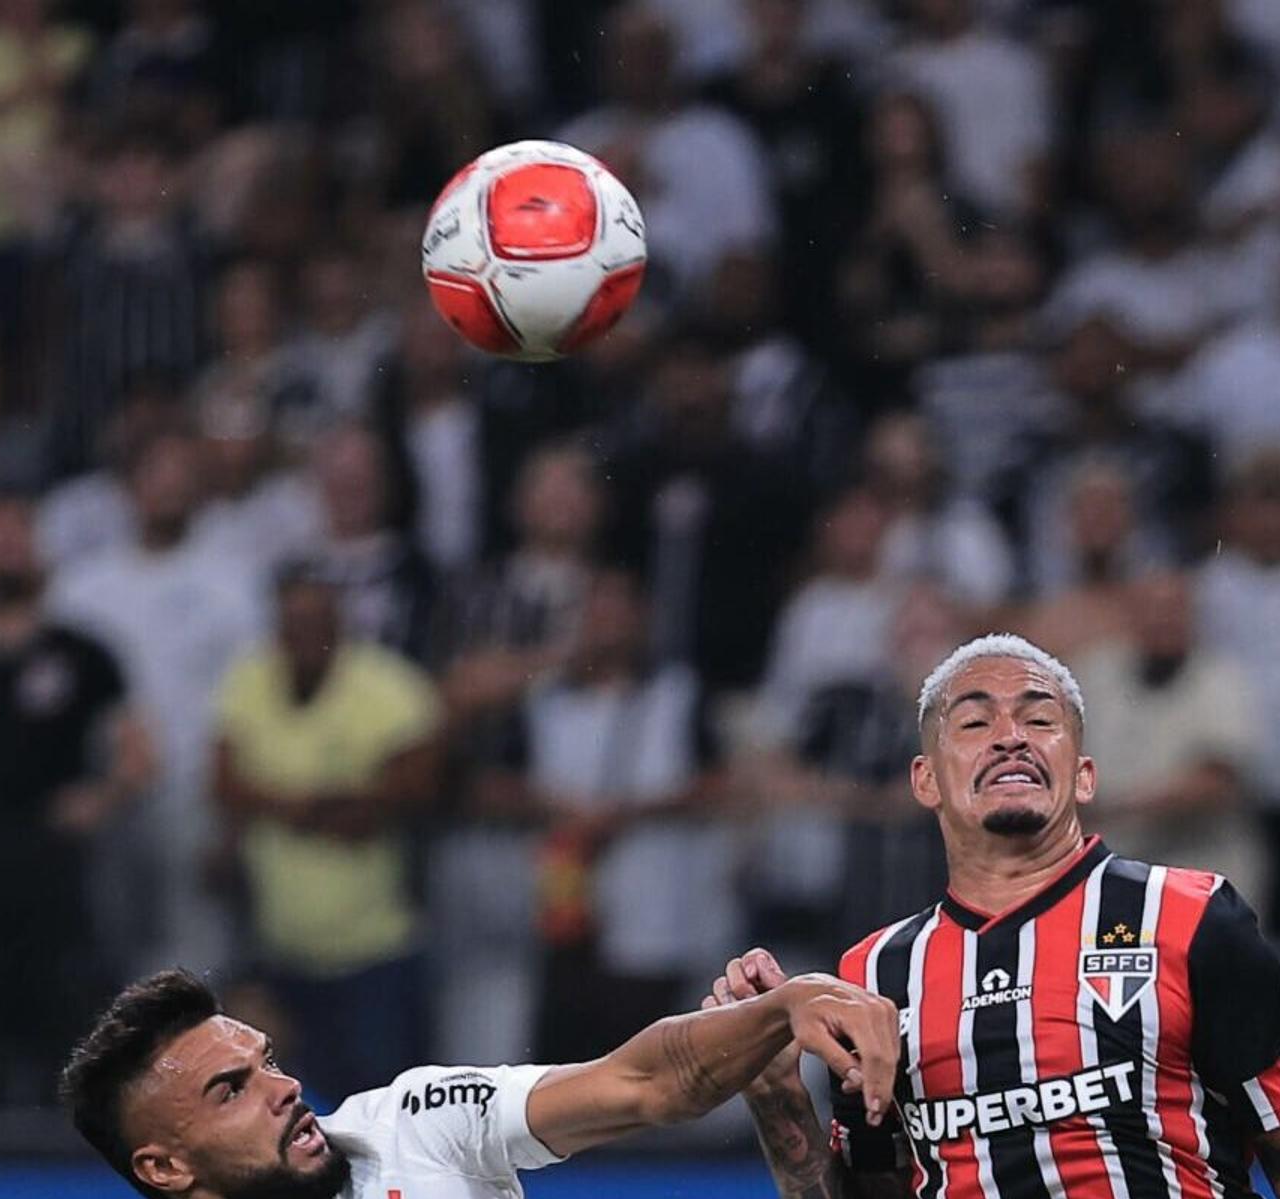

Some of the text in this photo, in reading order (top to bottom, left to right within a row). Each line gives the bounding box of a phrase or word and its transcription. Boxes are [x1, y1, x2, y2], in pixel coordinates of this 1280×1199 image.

[1086, 954, 1151, 972] SPFC
[961, 984, 1033, 1012] ADEMICON
[424, 1082, 497, 1118] bmg
[904, 1061, 1136, 1142] SUPERBET
